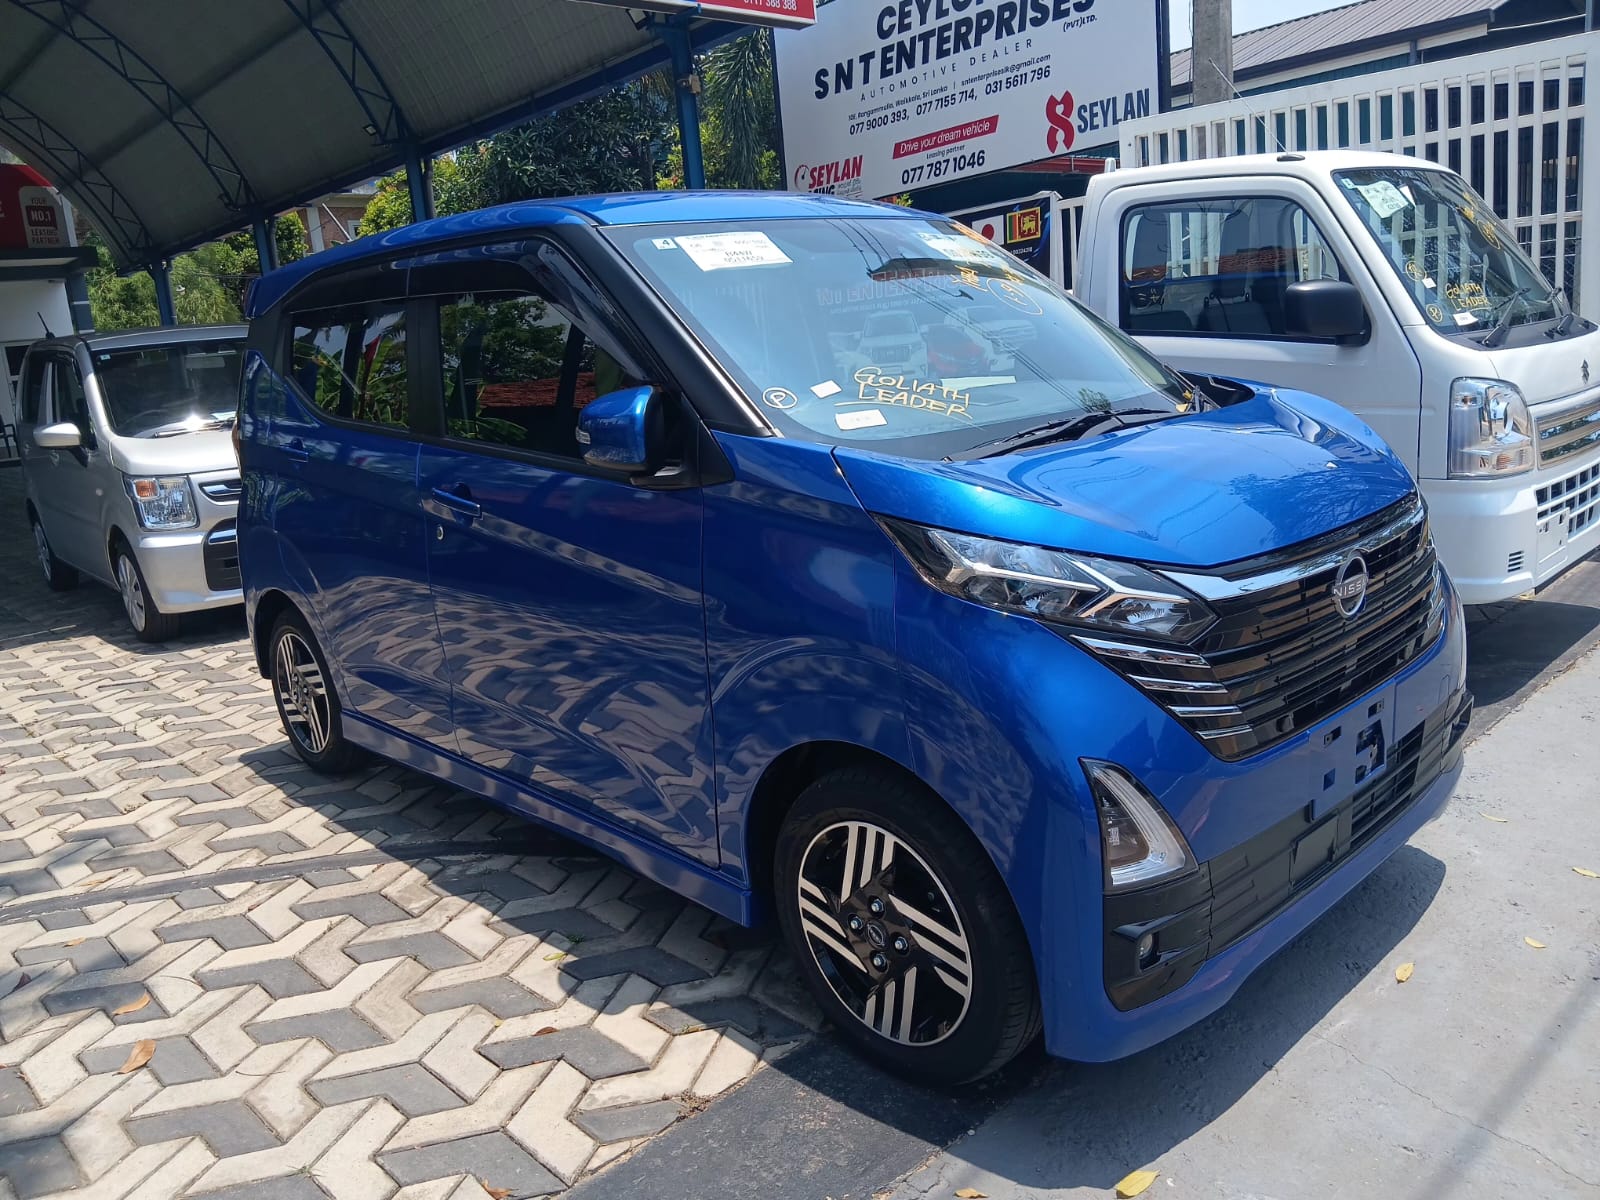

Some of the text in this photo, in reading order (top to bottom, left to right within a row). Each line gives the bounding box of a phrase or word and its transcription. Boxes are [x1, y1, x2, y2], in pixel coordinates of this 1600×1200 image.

[876, 0, 984, 40] CEYL
[860, 38, 1033, 101] AUTOMOTIVE DEALER
[849, 65, 1051, 136] 077 9000 393, 077 7155 714, 031 5611 796
[931, 85, 948, 96] Lanka
[1077, 88, 1150, 133] SEYLAN
[900, 121, 990, 154] Drive your dream vehicle
[808, 154, 863, 189] SEYLAN
[901, 150, 986, 185] 077 787 1046
[1451, 295, 1493, 311] LEADER
[853, 366, 970, 408] GOLIATH
[858, 381, 973, 419] LEADER
